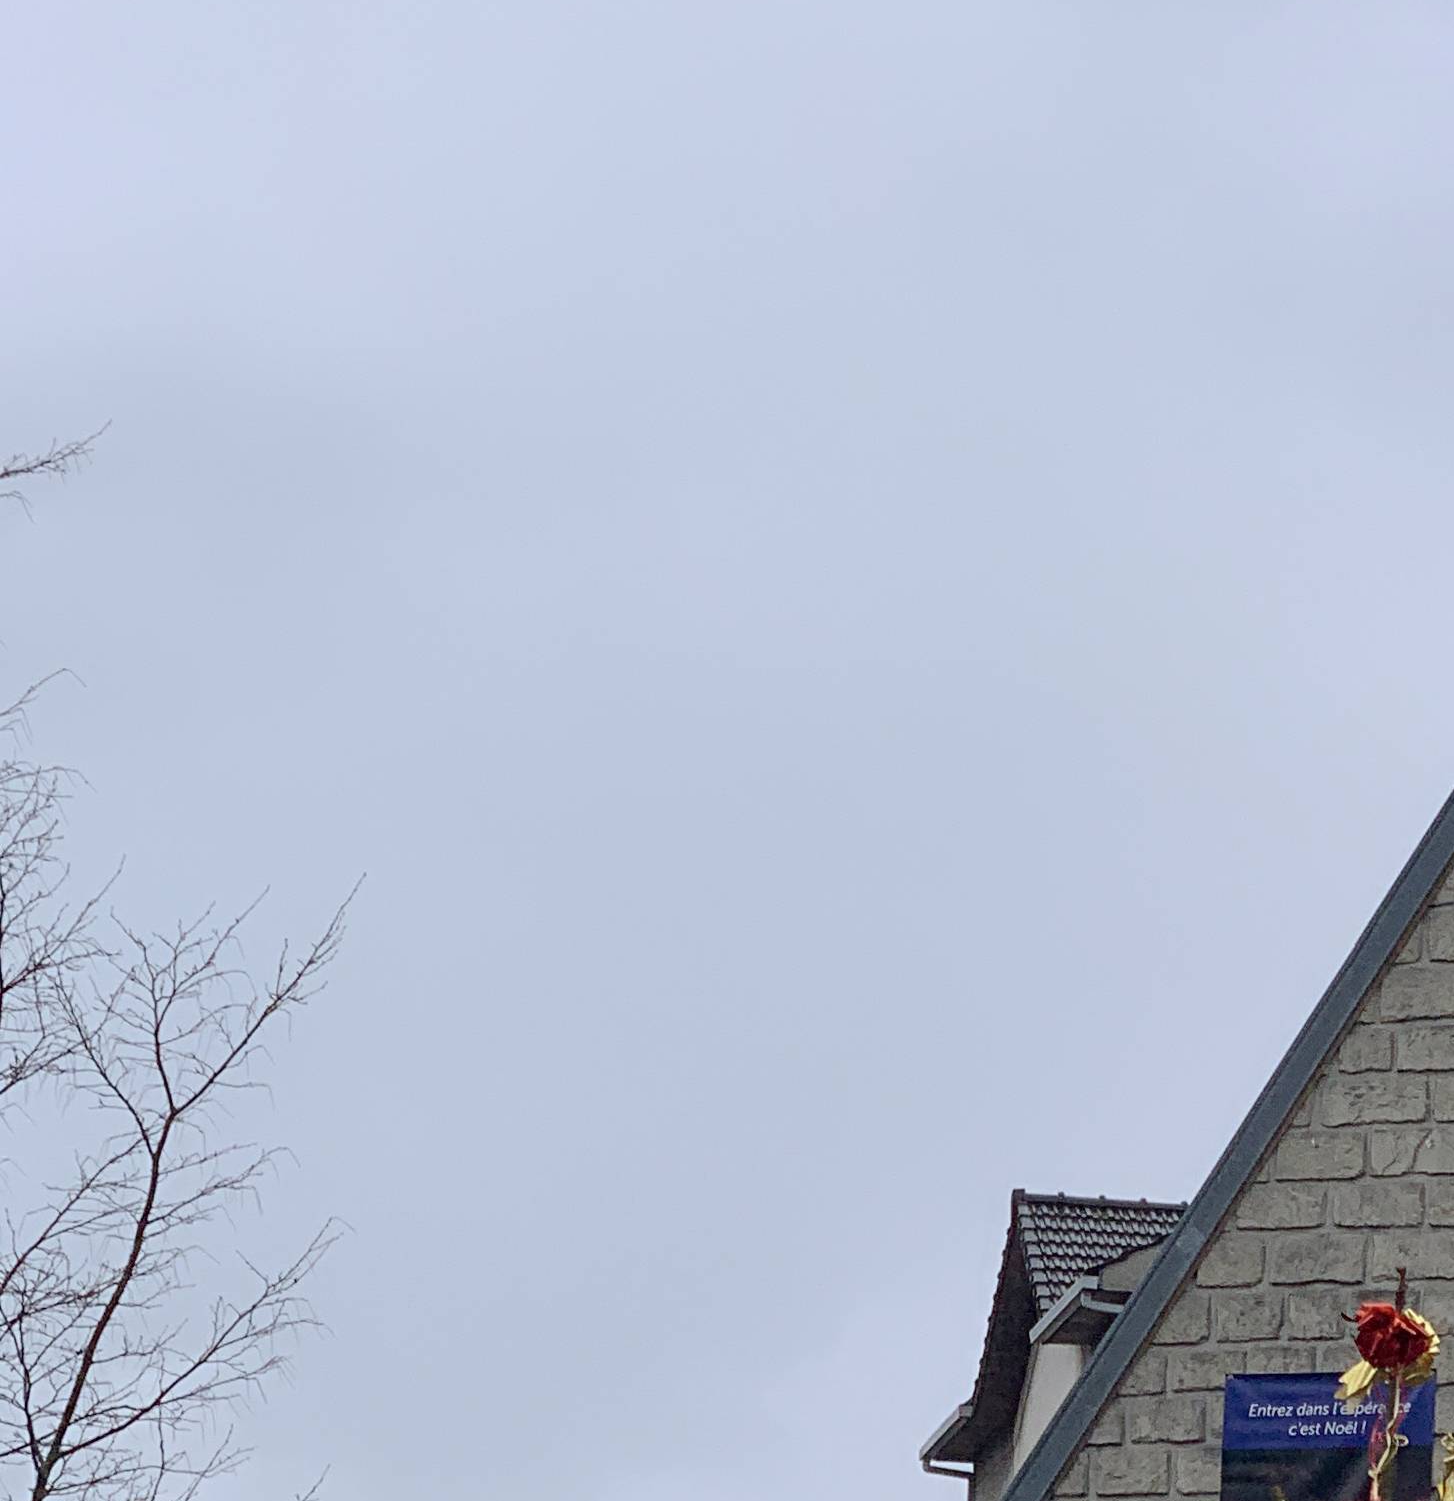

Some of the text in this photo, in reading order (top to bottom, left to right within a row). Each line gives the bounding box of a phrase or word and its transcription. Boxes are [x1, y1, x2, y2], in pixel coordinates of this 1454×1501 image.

[1248, 1403, 1293, 1418] Entrez
[1296, 1402, 1330, 1417] dans
[1288, 1420, 1322, 1436] c'est
[1323, 1420, 1358, 1436] Noël
